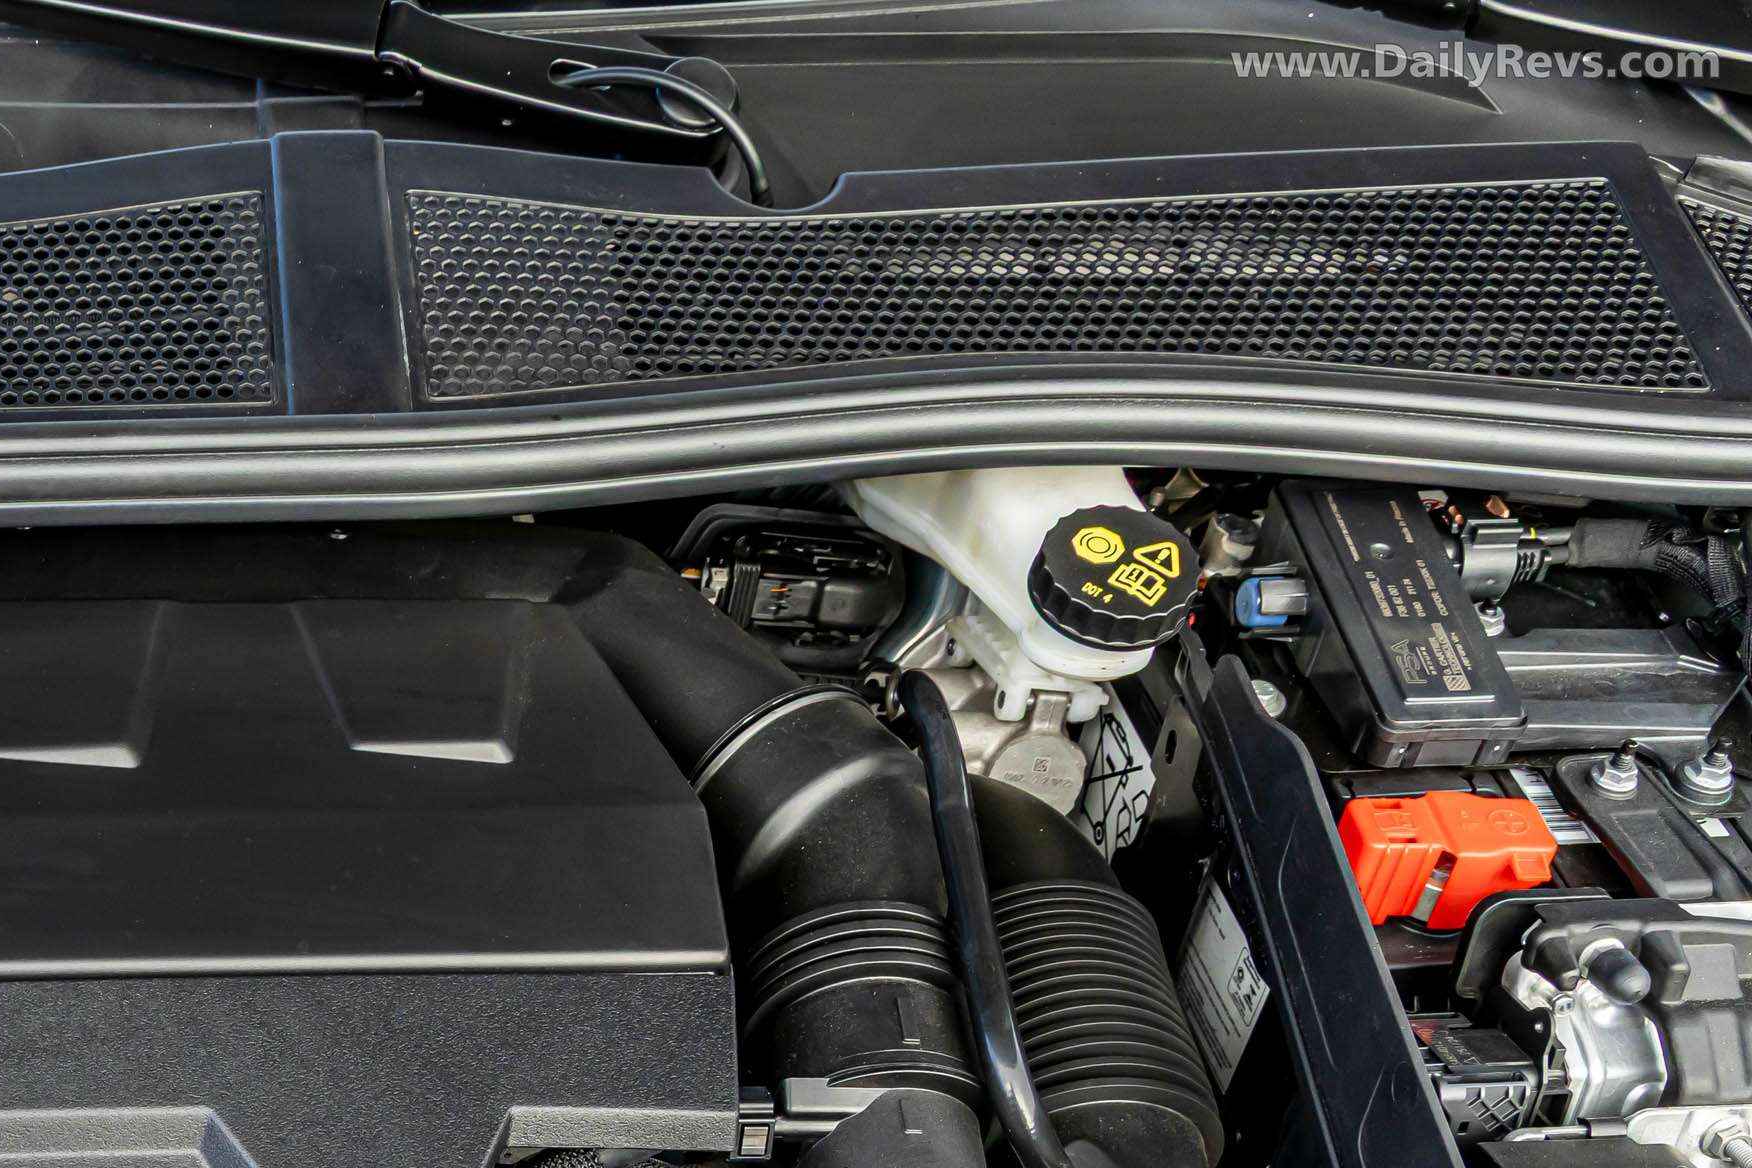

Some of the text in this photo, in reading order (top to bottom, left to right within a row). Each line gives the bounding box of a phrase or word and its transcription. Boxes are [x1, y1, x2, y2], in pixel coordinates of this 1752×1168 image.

[1081, 582, 1113, 603] DOT 4
[1391, 639, 1428, 684] PSA
